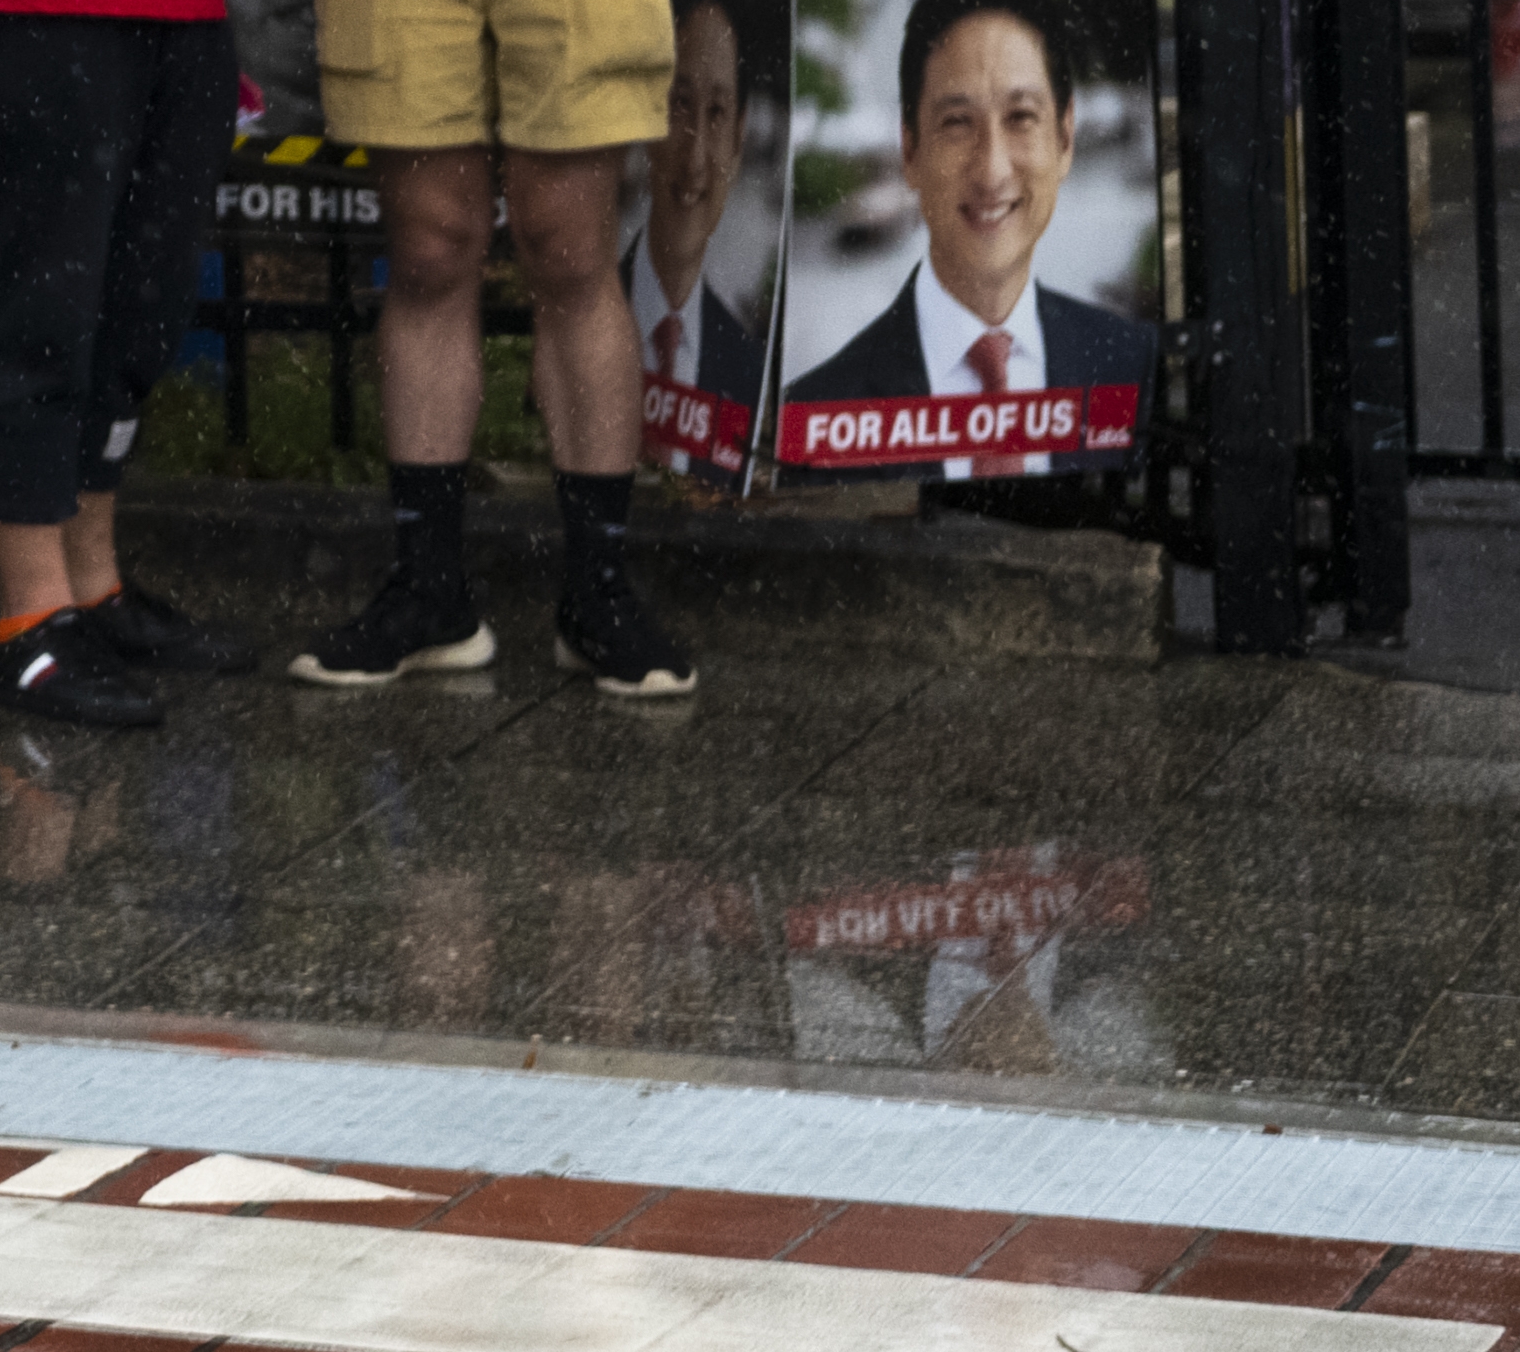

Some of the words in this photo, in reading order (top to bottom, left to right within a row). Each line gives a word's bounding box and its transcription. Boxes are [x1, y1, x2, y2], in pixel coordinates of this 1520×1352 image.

[215, 183, 301, 222] FOR
[309, 186, 382, 225] HIS
[644, 384, 678, 428] OF
[678, 395, 711, 442] US
[806, 410, 884, 454] FOR
[889, 406, 961, 447] ALL
[966, 401, 1020, 443] OF
[1025, 397, 1076, 439] US
